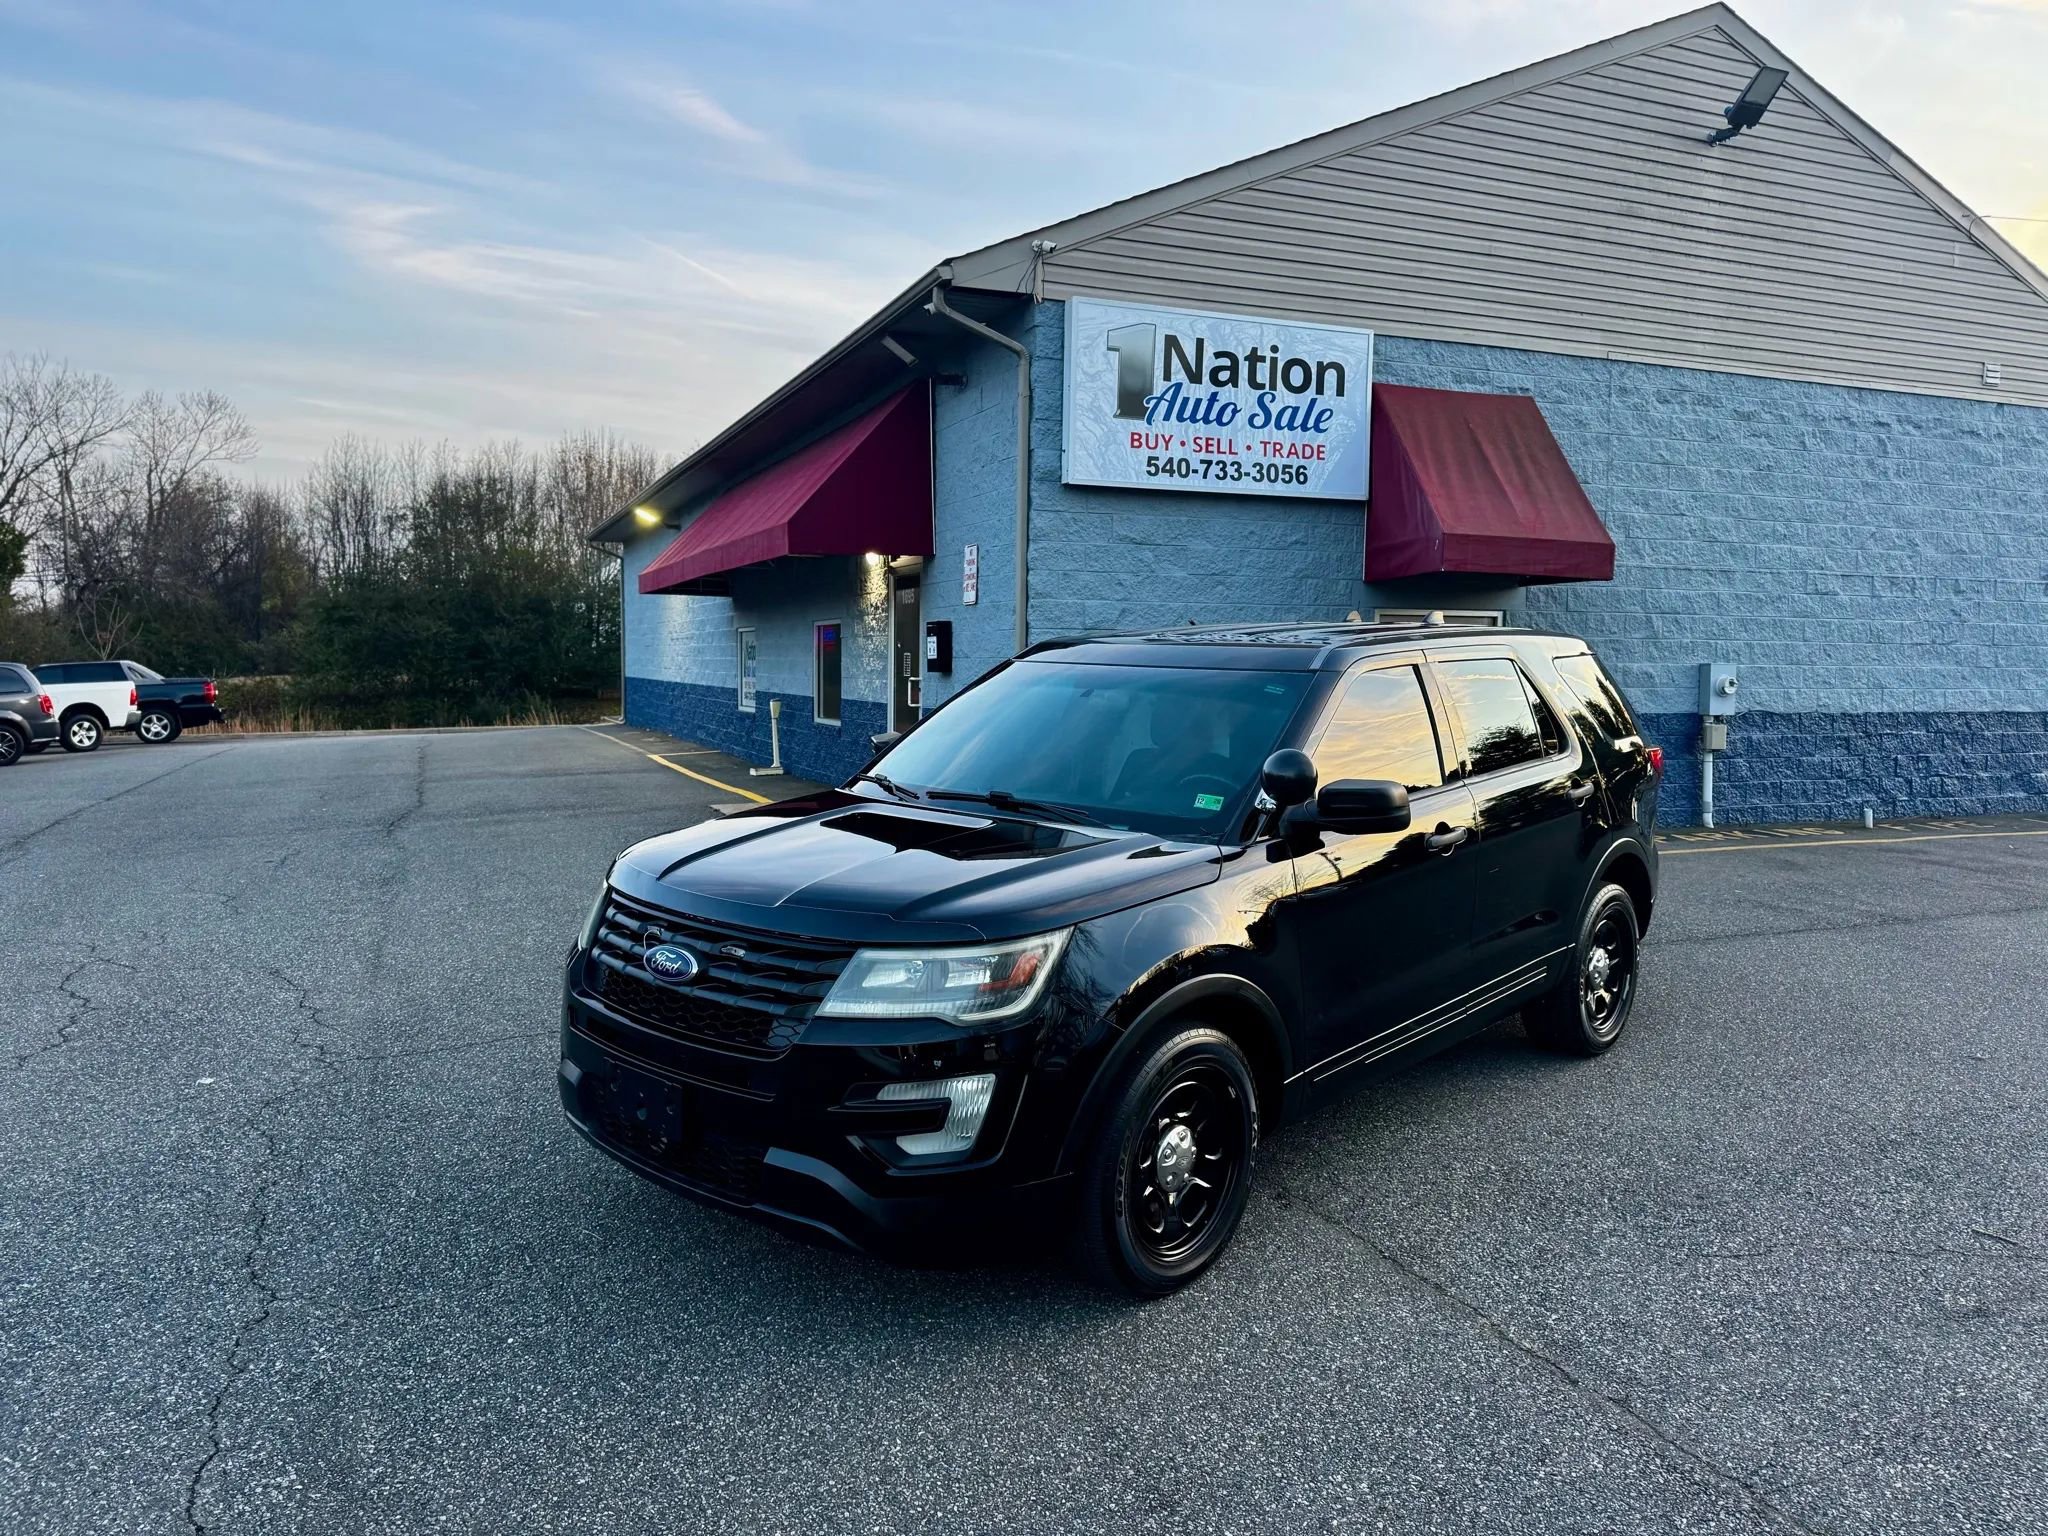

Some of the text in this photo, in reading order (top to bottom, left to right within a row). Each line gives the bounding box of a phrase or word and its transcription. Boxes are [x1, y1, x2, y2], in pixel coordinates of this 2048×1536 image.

[1107, 322, 1346, 419] 1 Nation
[1144, 382, 1334, 434] Auto Sale
[1130, 431, 1326, 461] BUY SELL TRADE
[1145, 456, 1309, 485] 540-733-3056
[651, 950, 682, 974] Ford
